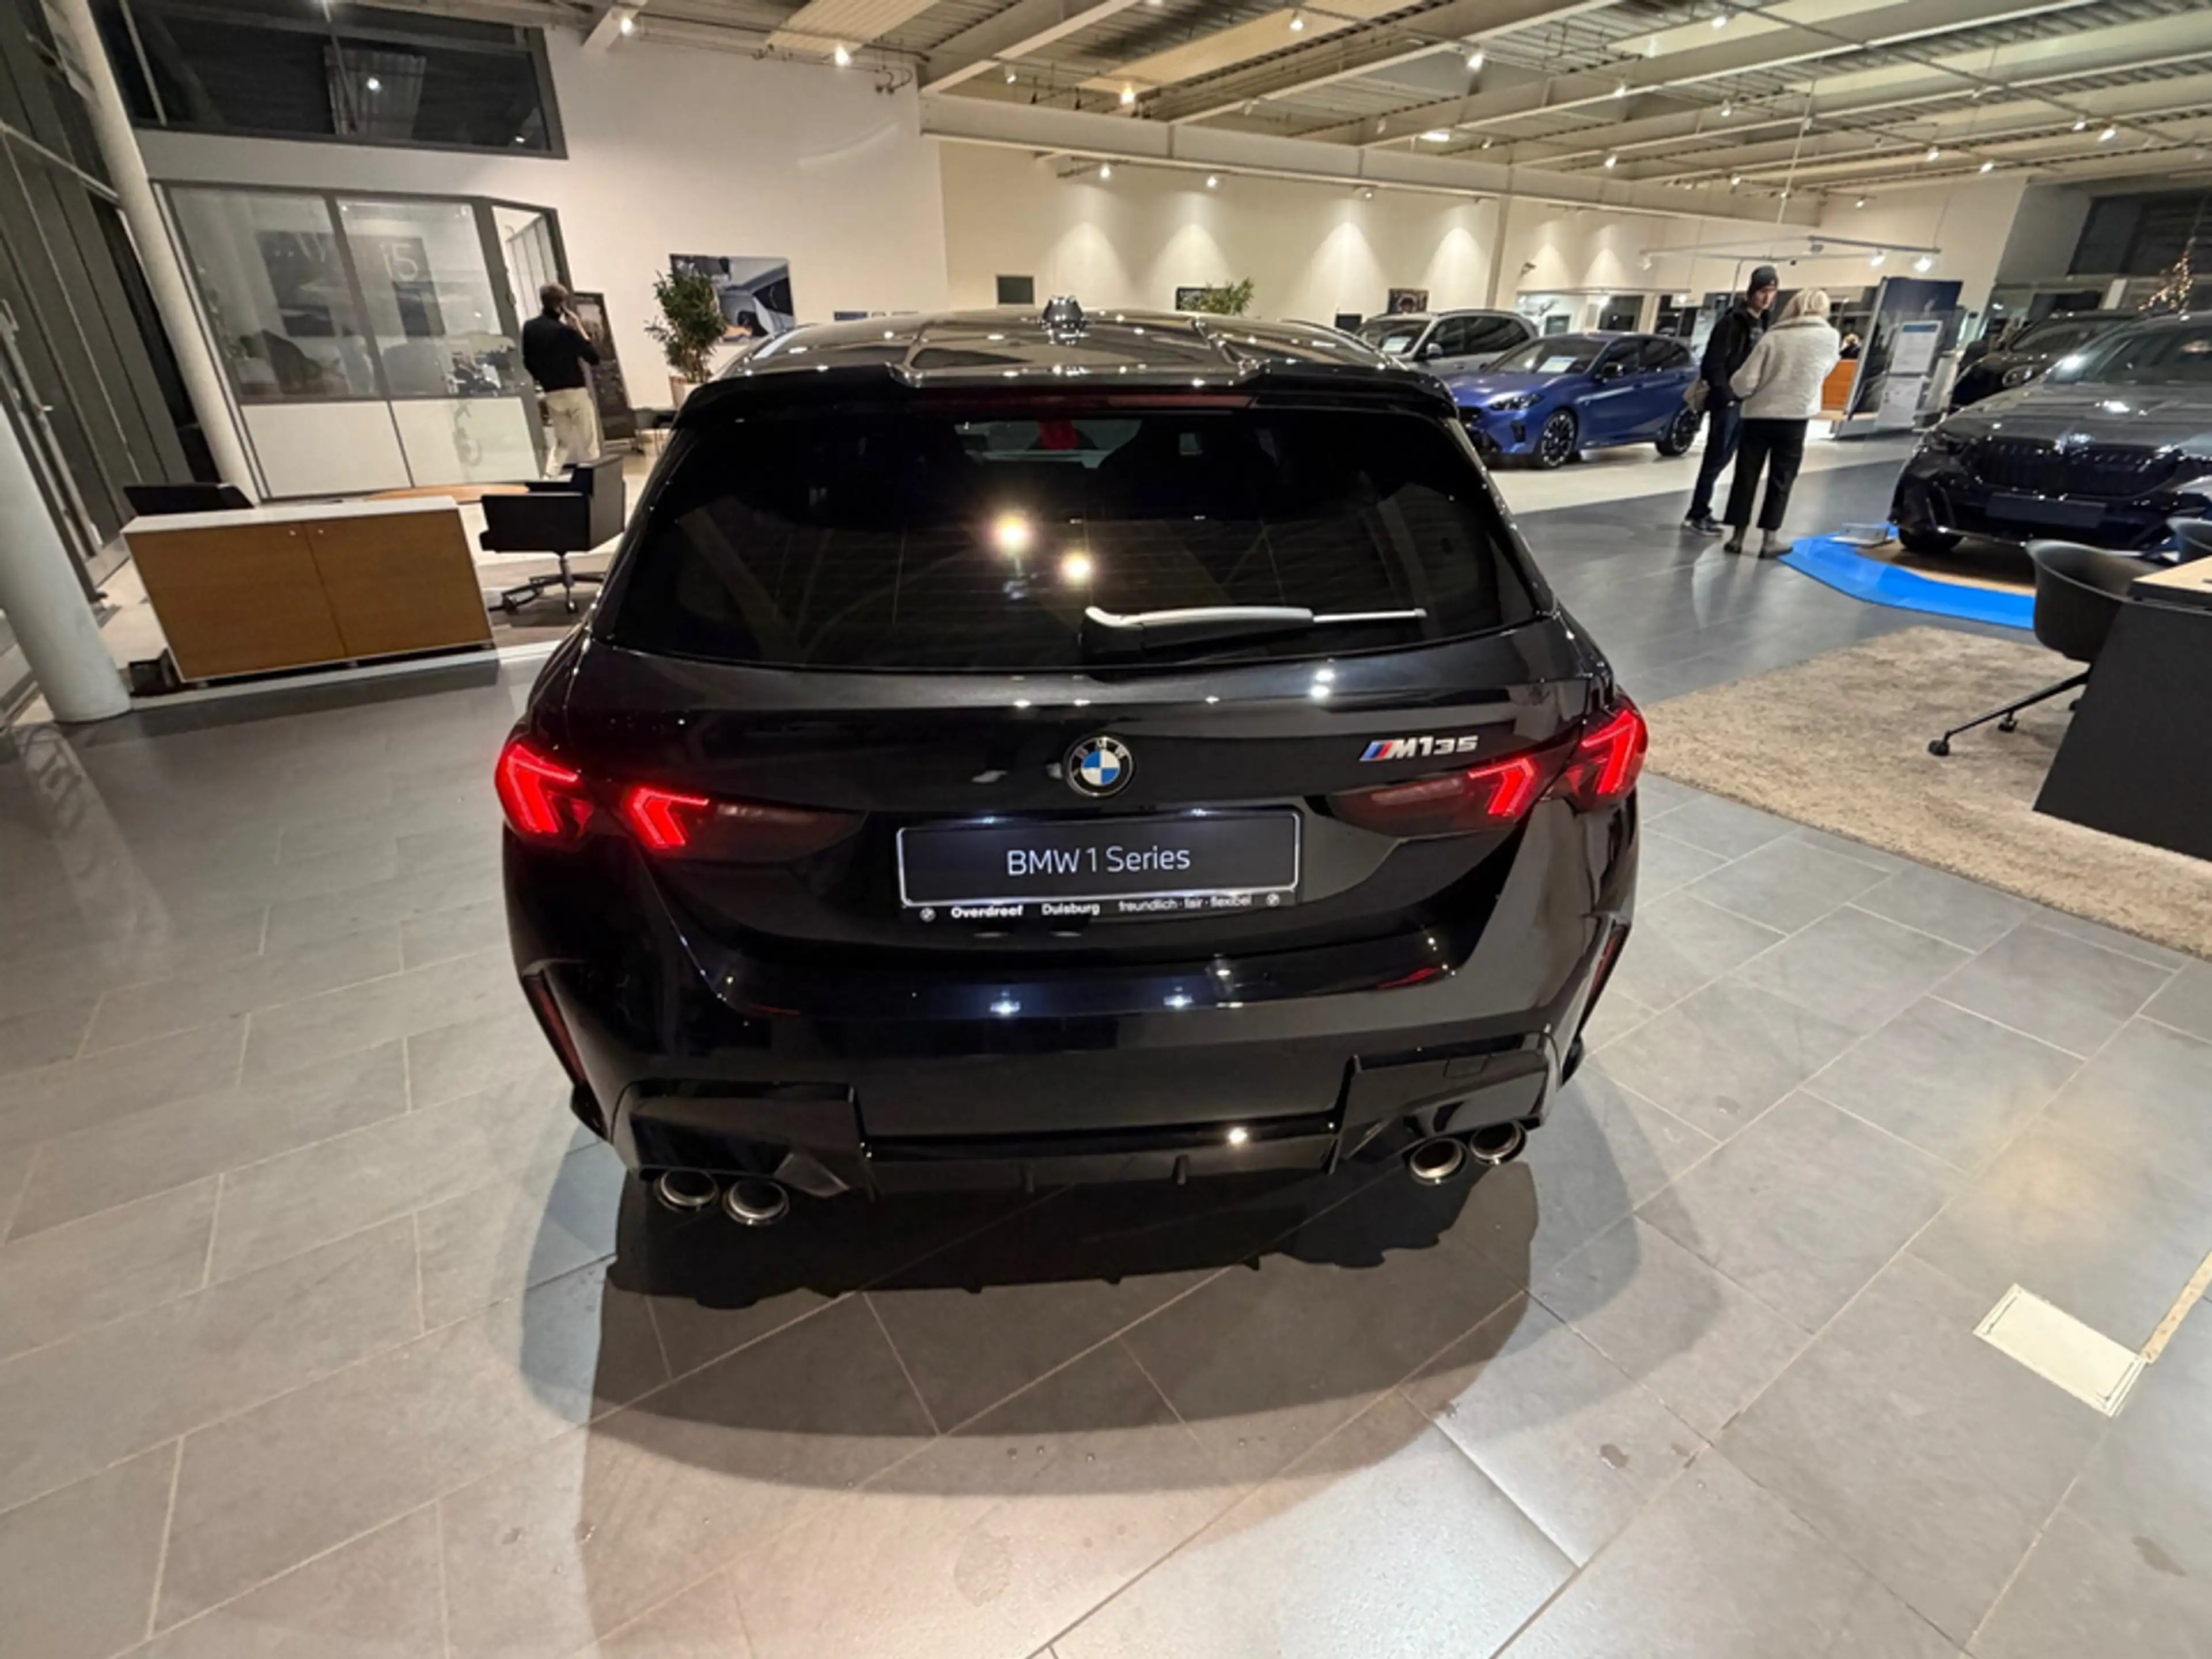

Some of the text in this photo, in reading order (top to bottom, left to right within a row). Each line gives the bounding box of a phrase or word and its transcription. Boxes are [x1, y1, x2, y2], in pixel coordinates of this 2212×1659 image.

[1382, 734, 1479, 759] M135
[1007, 845, 1191, 876] BMW 1 Series
[1041, 902, 1100, 916] Duisburg
[1118, 899, 1177, 912] freundlich
